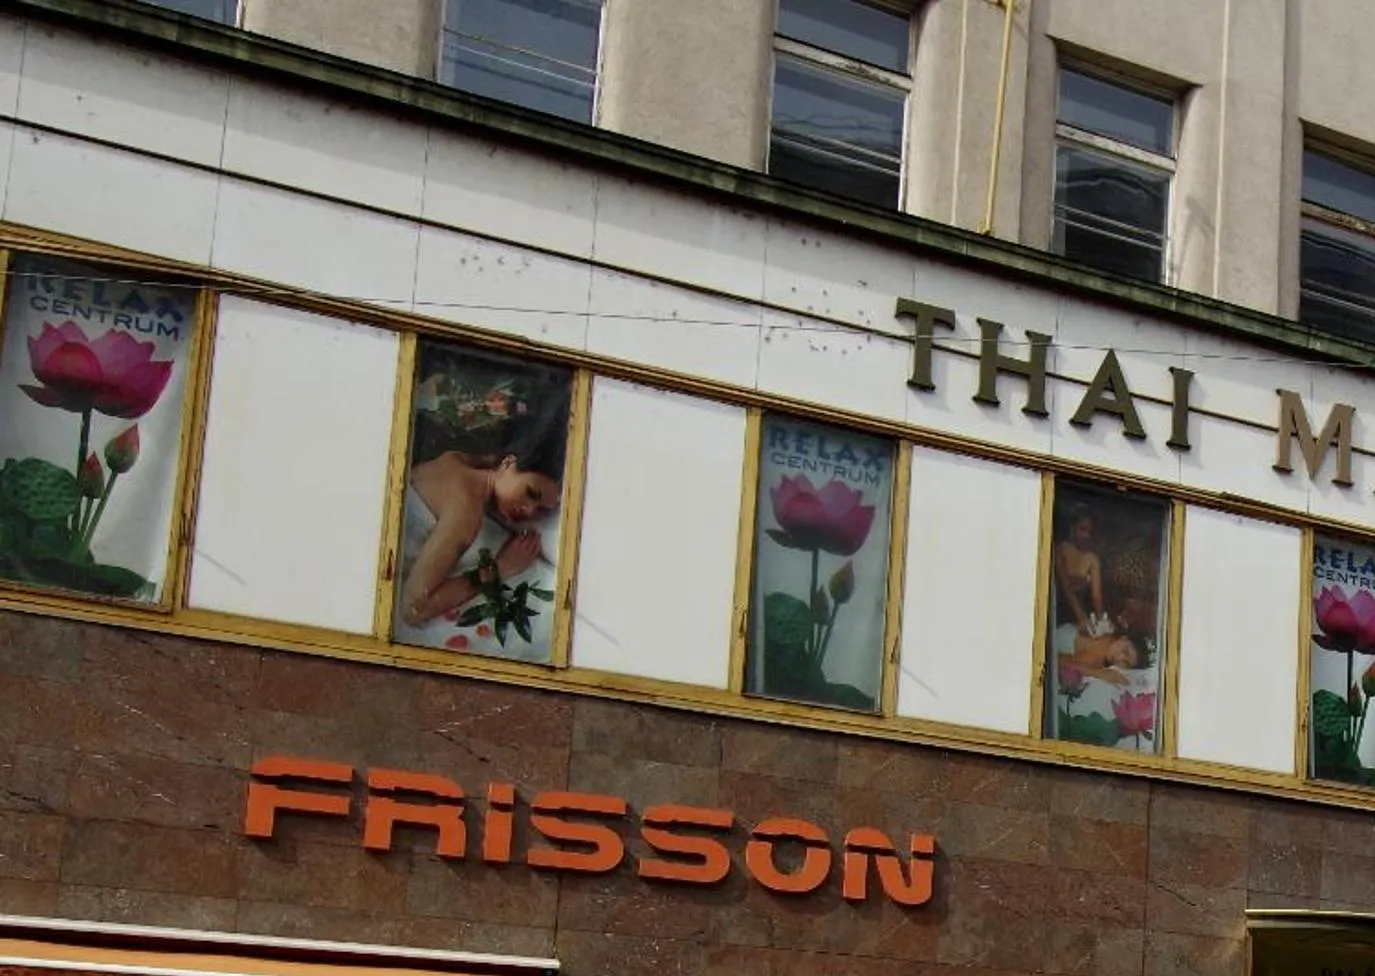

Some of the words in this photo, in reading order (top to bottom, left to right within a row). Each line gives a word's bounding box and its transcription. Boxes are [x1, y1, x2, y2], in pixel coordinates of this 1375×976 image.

[30, 295, 181, 341] CENTRUM
[895, 297, 1194, 451] THAI
[769, 425, 887, 471] RELAX
[770, 452, 882, 488] CENTRUM
[244, 756, 934, 905] FRISSON
